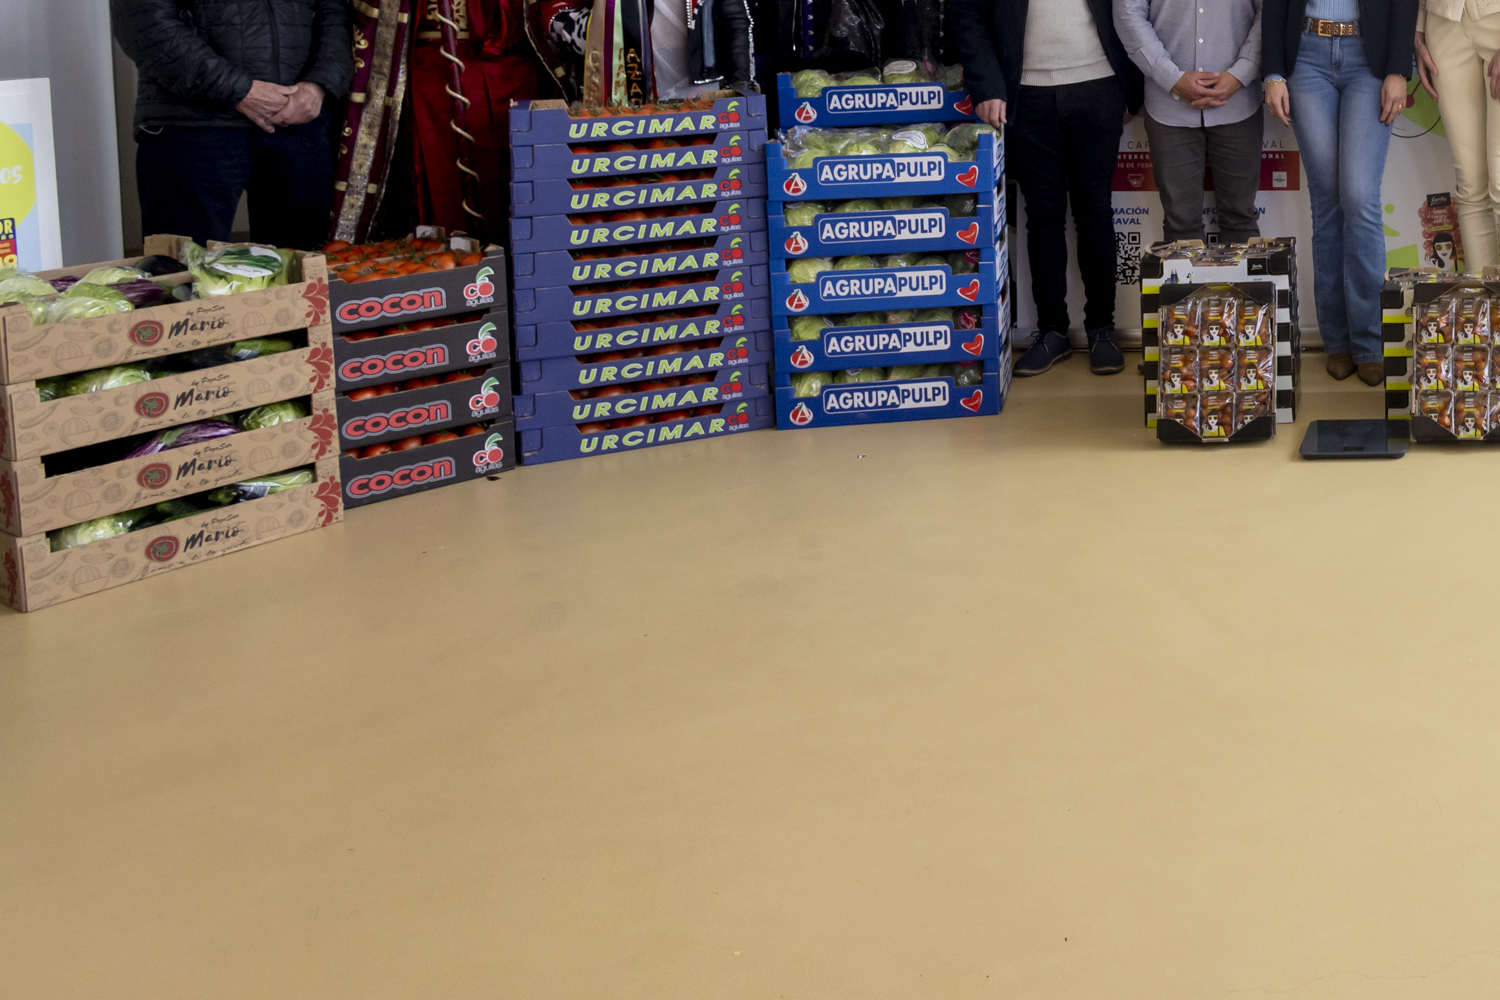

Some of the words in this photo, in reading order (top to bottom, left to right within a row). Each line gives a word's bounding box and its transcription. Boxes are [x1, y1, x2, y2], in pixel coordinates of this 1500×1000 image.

[829, 89, 942, 110] AGRUPAPULPI
[569, 115, 716, 138] URCIMAR
[571, 150, 718, 174] URCIMAR
[1117, 152, 1150, 160] NTERÉS
[820, 159, 942, 182] AGRUPAPULPI
[570, 184, 718, 209] URCIMAR
[1112, 206, 1149, 215] MACIÓN
[570, 218, 717, 244] URCIMAR
[822, 216, 944, 240] AGRUPAPULPI
[572, 252, 719, 280] URCIMAR
[822, 274, 944, 297] AGRUPAPULPI
[572, 286, 720, 316] URCIMAR
[168, 318, 230, 339] Mario
[573, 319, 720, 350] URCIMAR
[827, 329, 948, 353] AGRUPAPULPI
[578, 352, 724, 384] URCIMAR
[174, 386, 232, 410] Mario
[572, 386, 718, 420] URCIMAR
[826, 386, 947, 410] AGRUPAPULPI
[580, 418, 726, 452] URCIMAR
[176, 455, 236, 480] Mario
[184, 526, 244, 552] Mario
